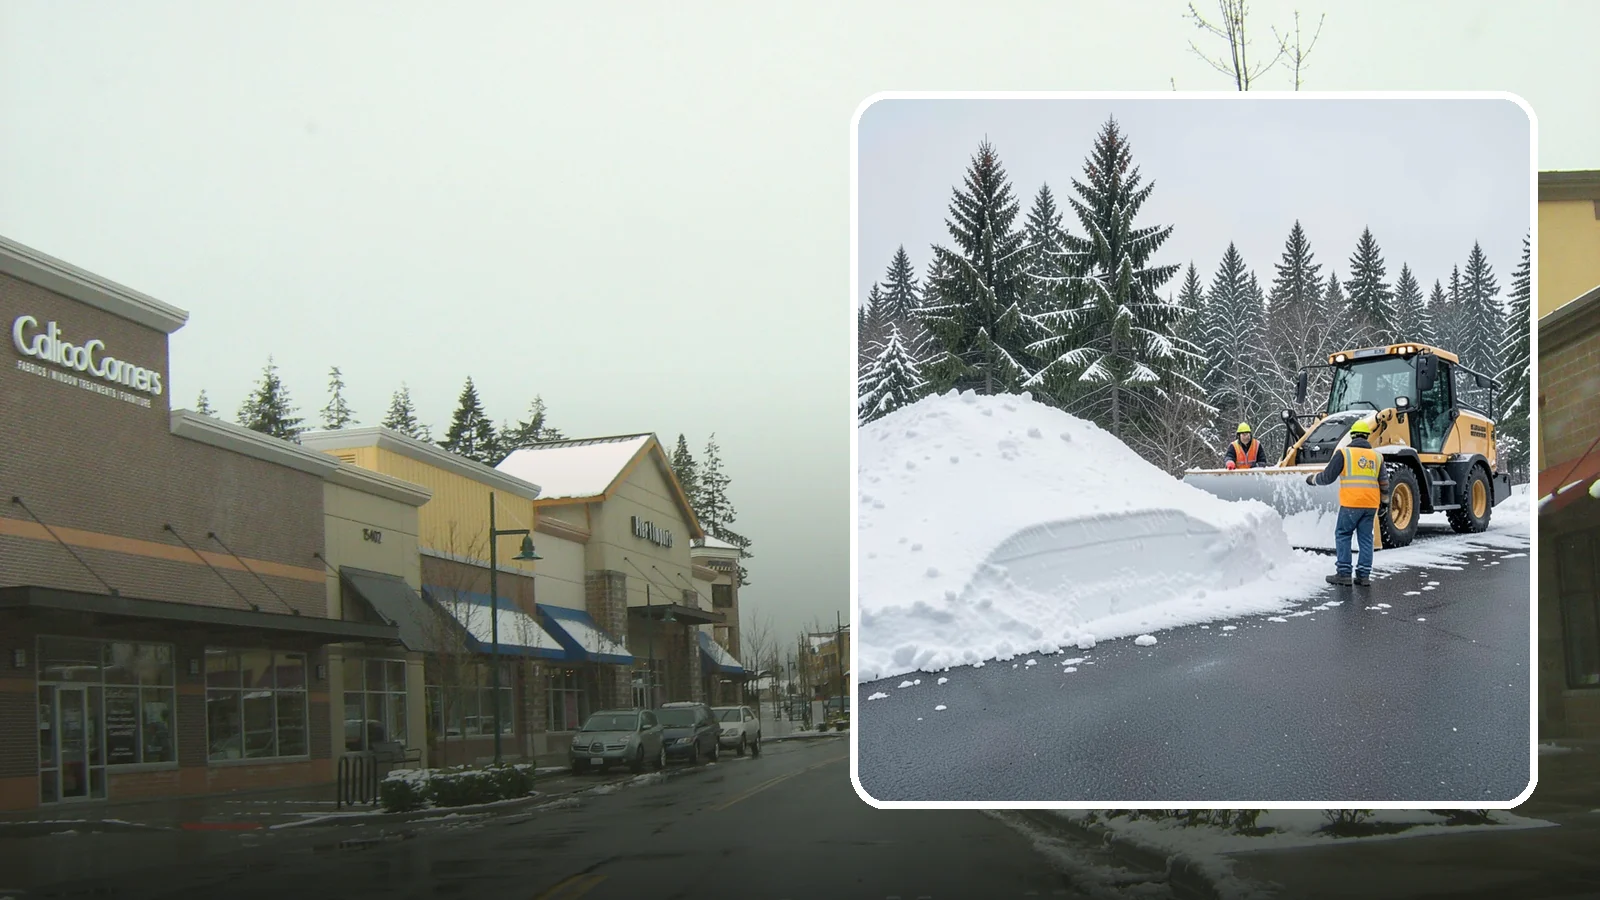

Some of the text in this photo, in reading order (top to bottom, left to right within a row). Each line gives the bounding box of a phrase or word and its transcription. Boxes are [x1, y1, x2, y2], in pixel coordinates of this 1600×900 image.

[17, 360, 47, 377] FABRICS
[51, 370, 78, 386] WINDOW
[79, 378, 116, 398] TREATMENTS
